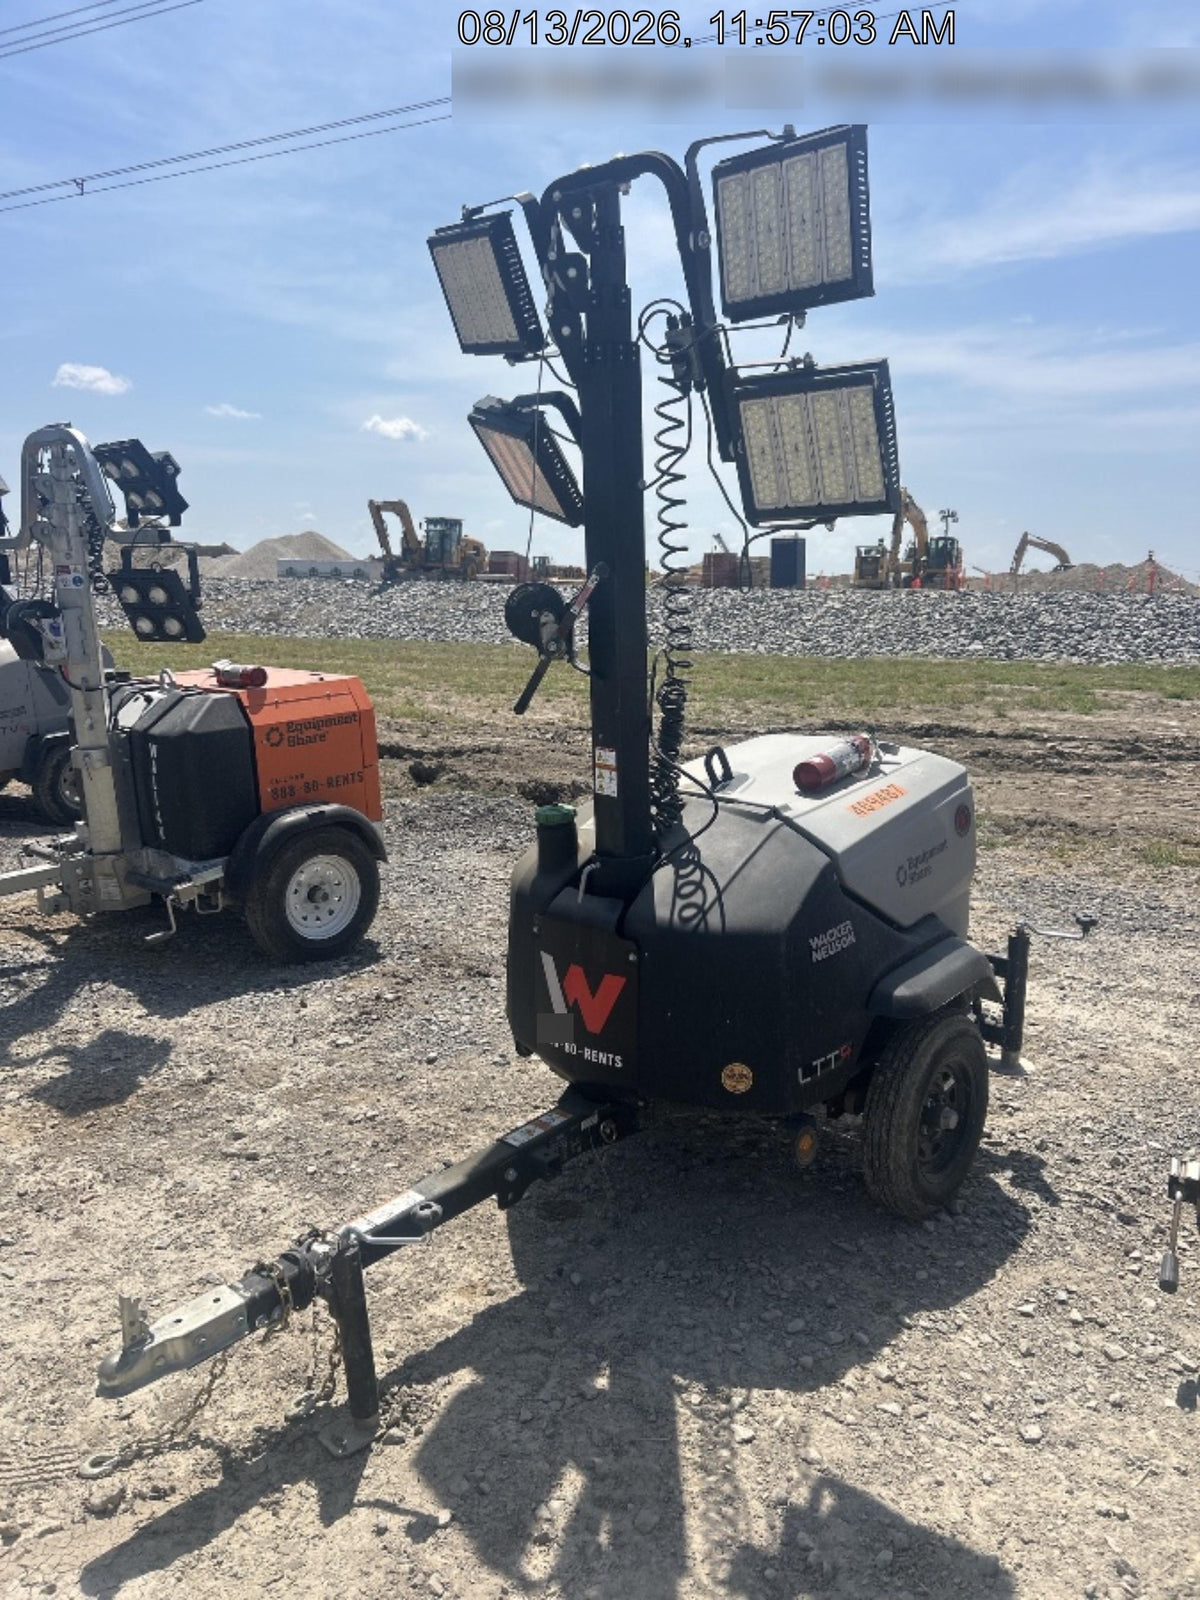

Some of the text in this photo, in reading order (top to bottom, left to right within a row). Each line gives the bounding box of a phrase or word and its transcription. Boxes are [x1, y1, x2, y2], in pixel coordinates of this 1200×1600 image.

[286, 712, 358, 735] Equipment
[287, 733, 326, 748] Share
[808, 920, 853, 950] WACKER
[811, 931, 857, 964] NEUSON
